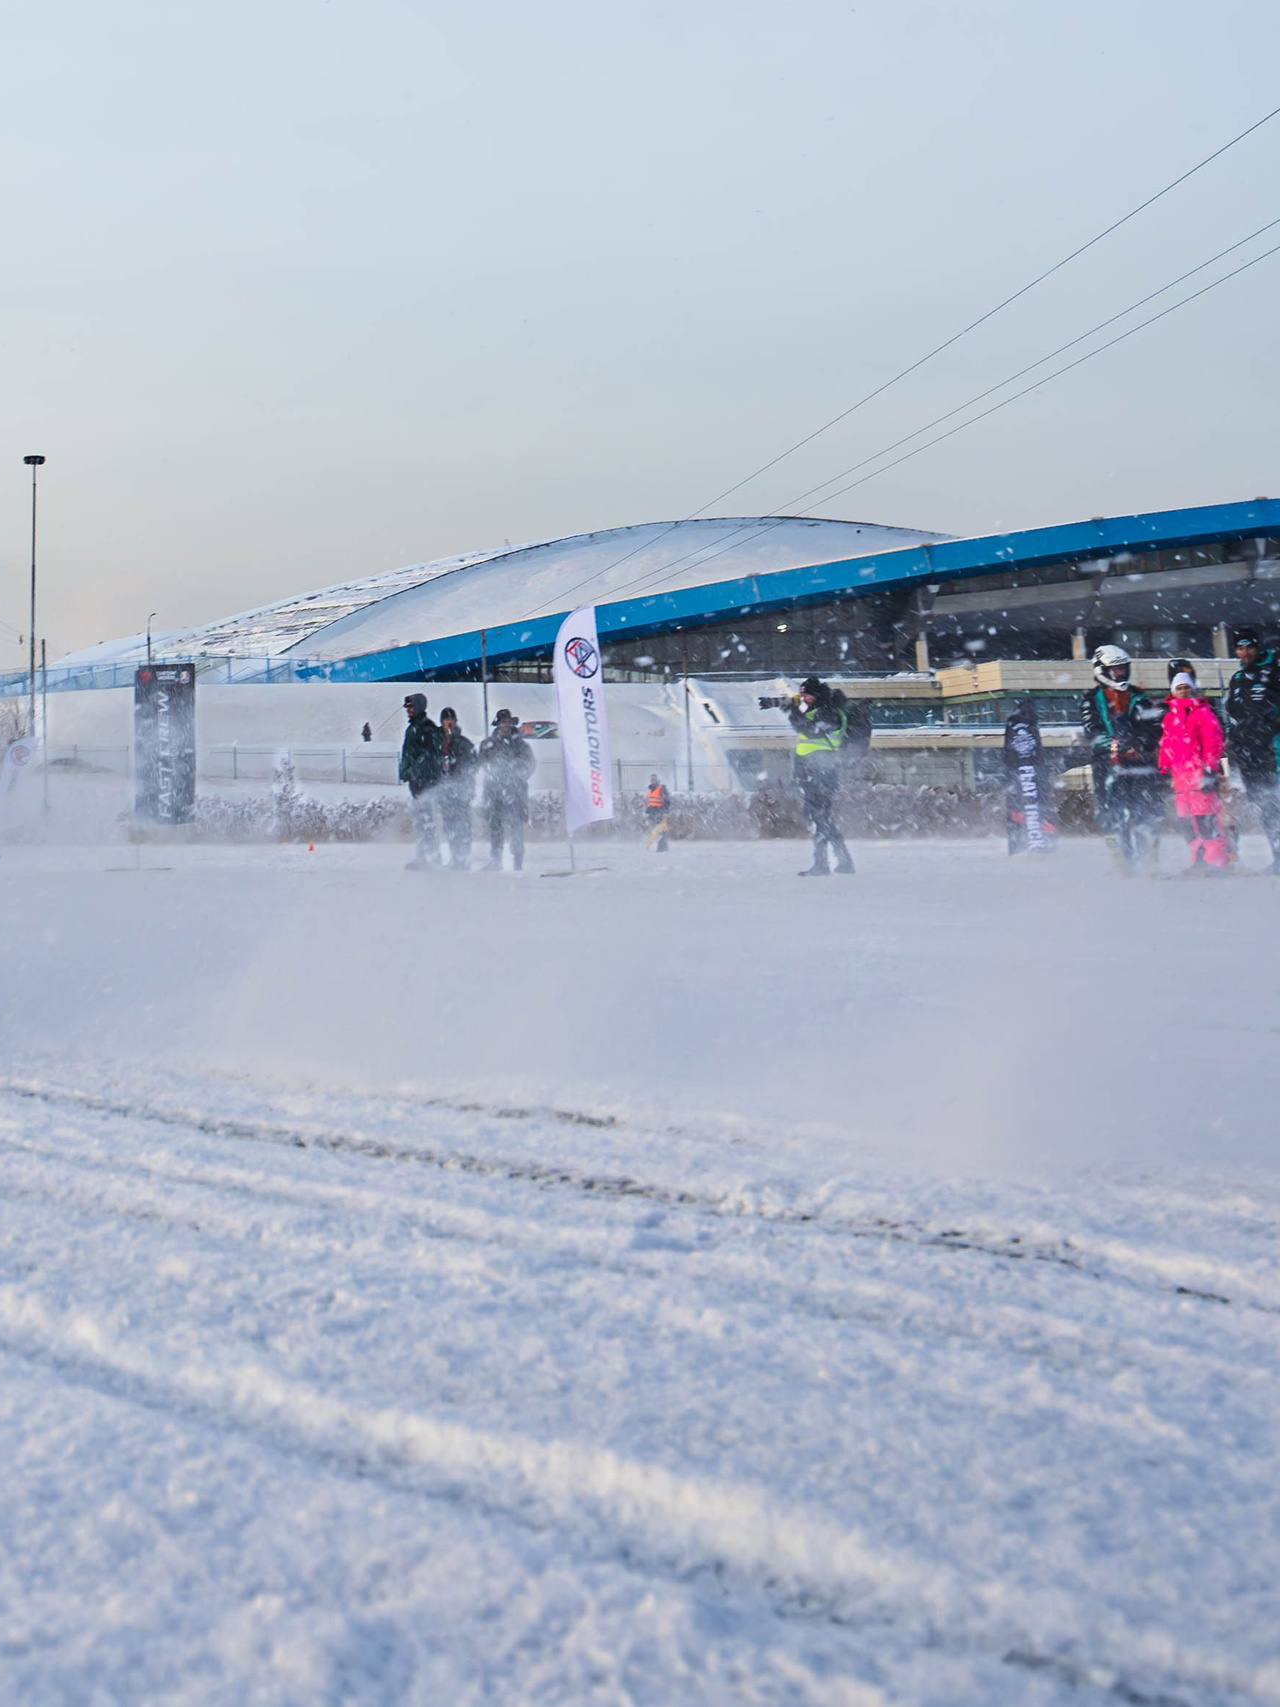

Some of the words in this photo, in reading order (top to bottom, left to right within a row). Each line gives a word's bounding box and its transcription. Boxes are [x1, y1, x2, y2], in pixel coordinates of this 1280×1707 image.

[156, 691, 170, 756] CREW
[581, 685, 605, 809] SPRMOTORS
[157, 760, 172, 819] FAST
[1018, 765, 1038, 798] FLAT
[1024, 802, 1046, 850] TRACK
